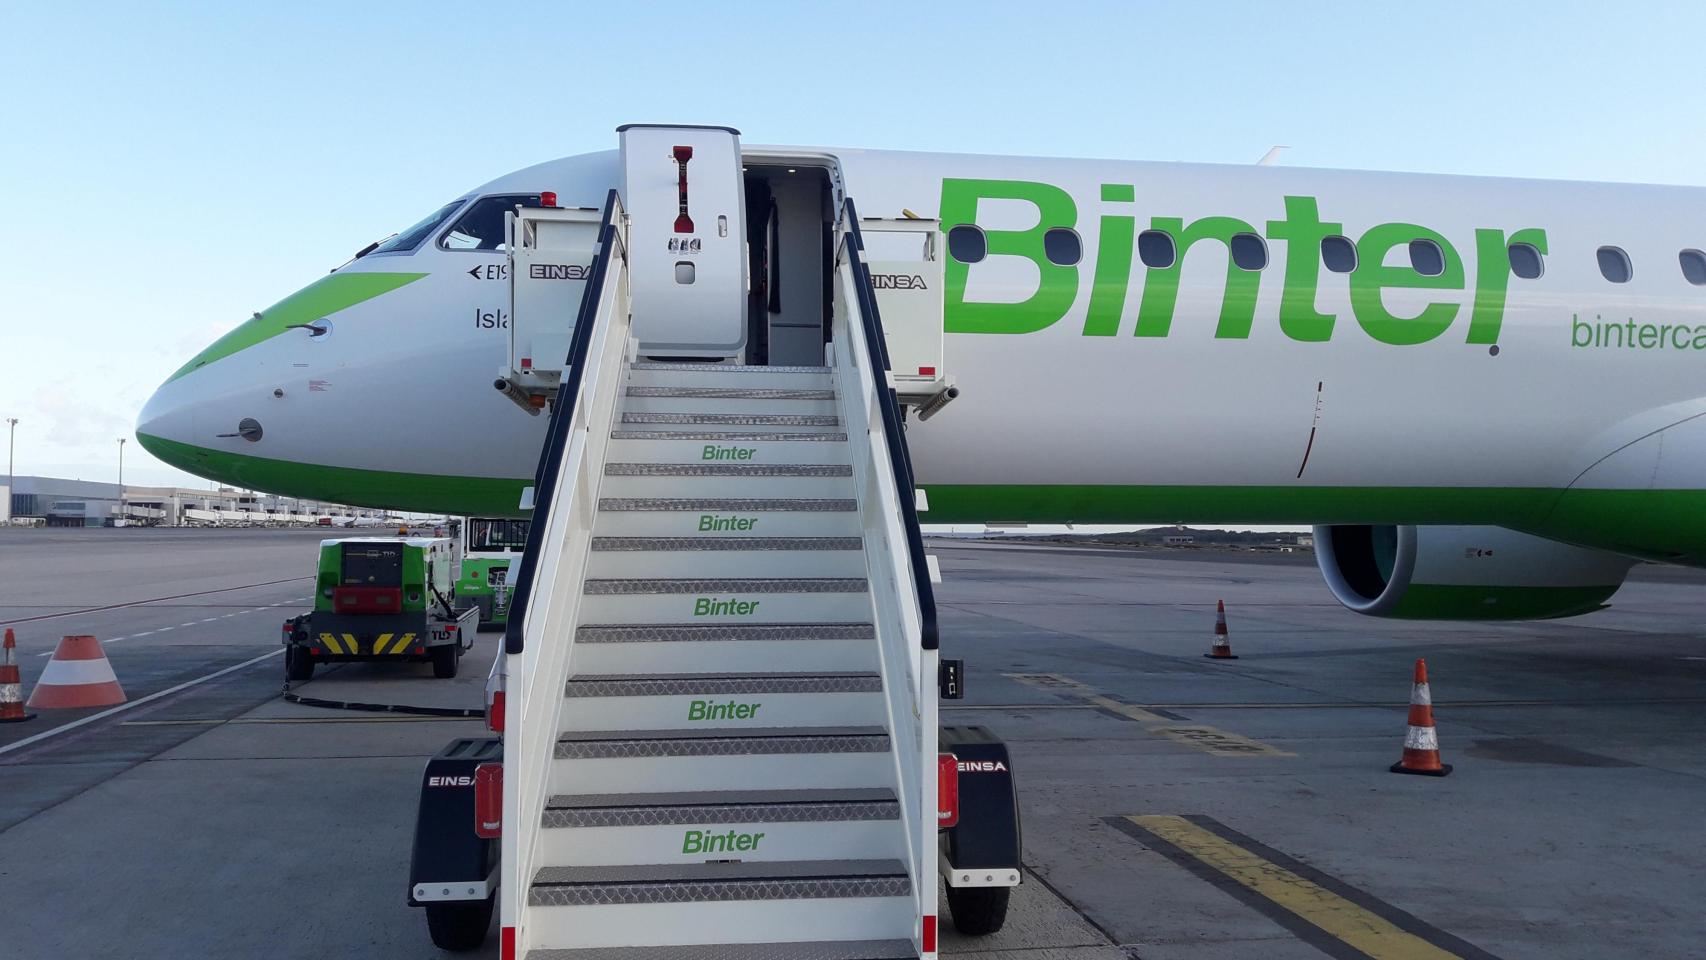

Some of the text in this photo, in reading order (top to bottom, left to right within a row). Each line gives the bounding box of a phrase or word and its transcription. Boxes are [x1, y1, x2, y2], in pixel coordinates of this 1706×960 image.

[939, 178, 1548, 346] Binter
[702, 445, 756, 461] Binter
[698, 514, 758, 532] Binter
[693, 598, 760, 616] Binter
[688, 700, 761, 721] Binter
[682, 830, 765, 854] Binter
